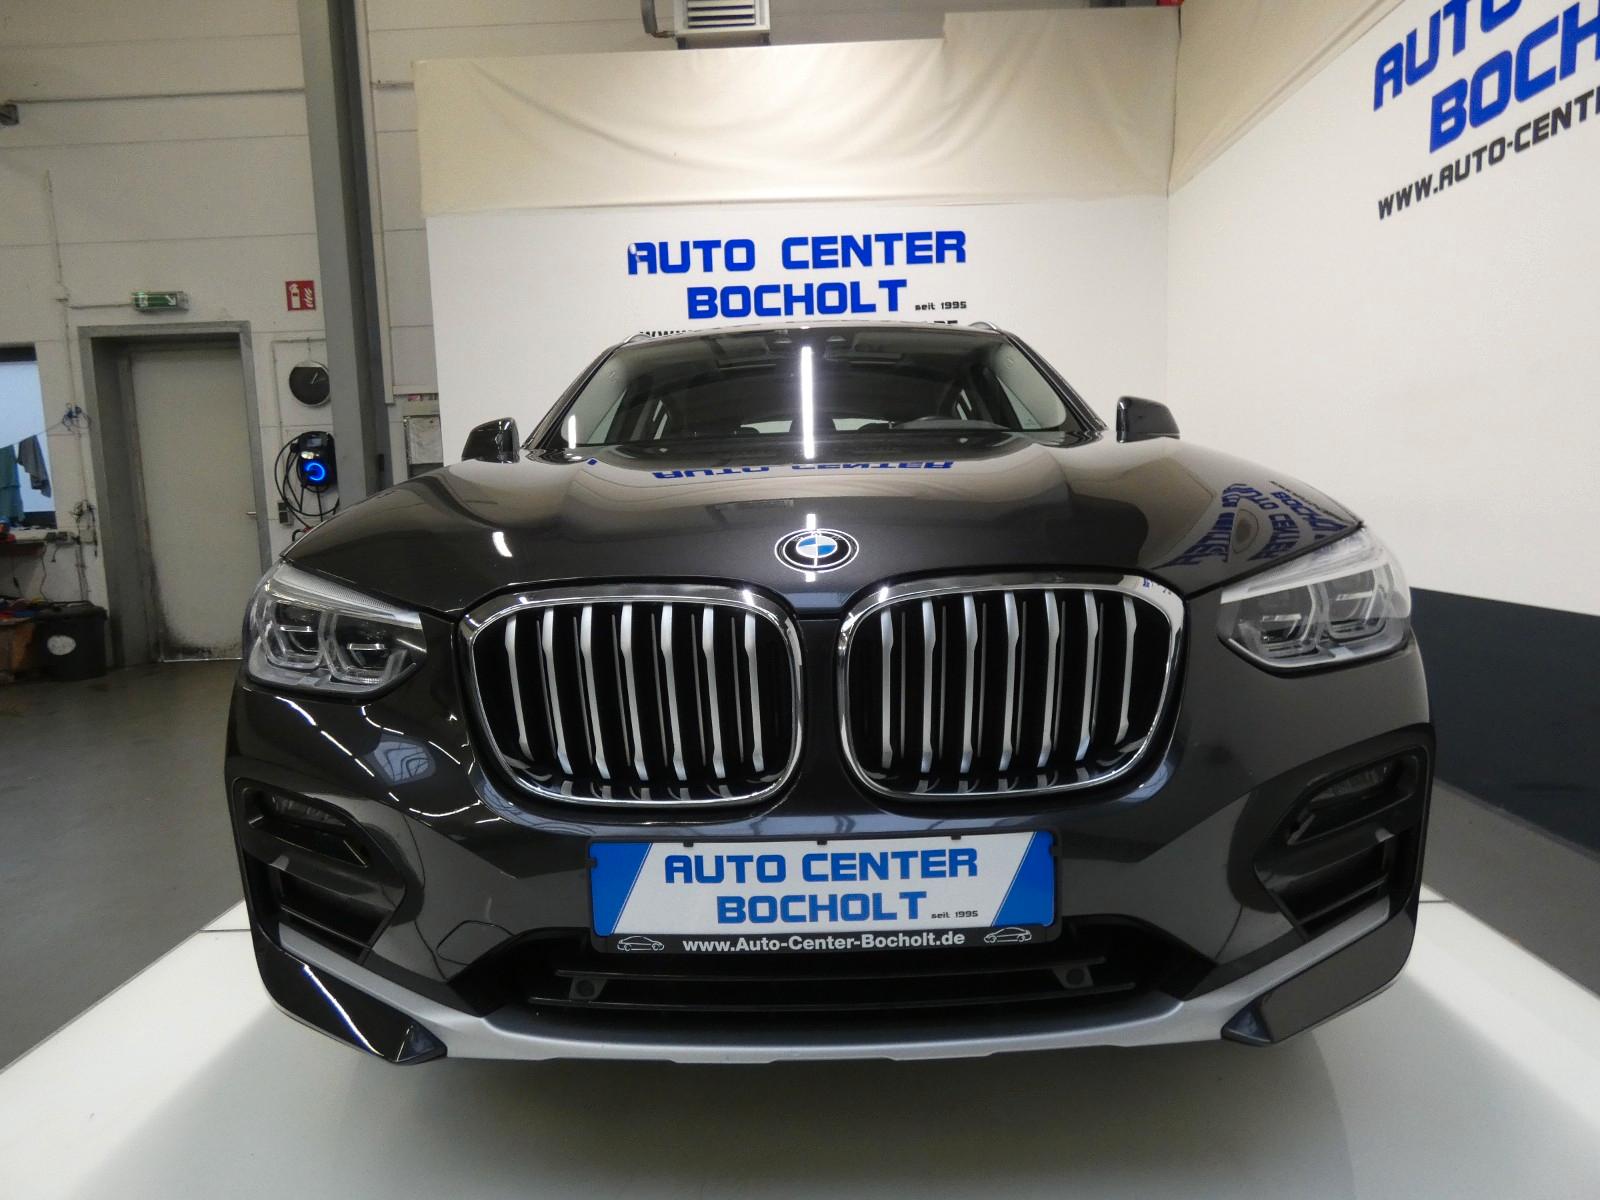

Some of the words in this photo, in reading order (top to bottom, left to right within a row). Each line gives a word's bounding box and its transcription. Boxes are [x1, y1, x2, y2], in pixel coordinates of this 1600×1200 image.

[1378, 86, 1600, 220] WWW.AUTO-CENT
[628, 238, 756, 275] AUTO
[781, 230, 966, 270] CENTER
[687, 279, 907, 319] BOCHOLT
[915, 302, 936, 311] seit
[941, 300, 967, 310] 1995
[664, 854, 787, 884] AUTO
[801, 848, 978, 882] CENTER
[717, 891, 927, 924] BOCHOLT
[931, 911, 950, 919] seit
[954, 910, 979, 918] 1995
[682, 930, 965, 952] www.Auto-Center-Bocholt.de
